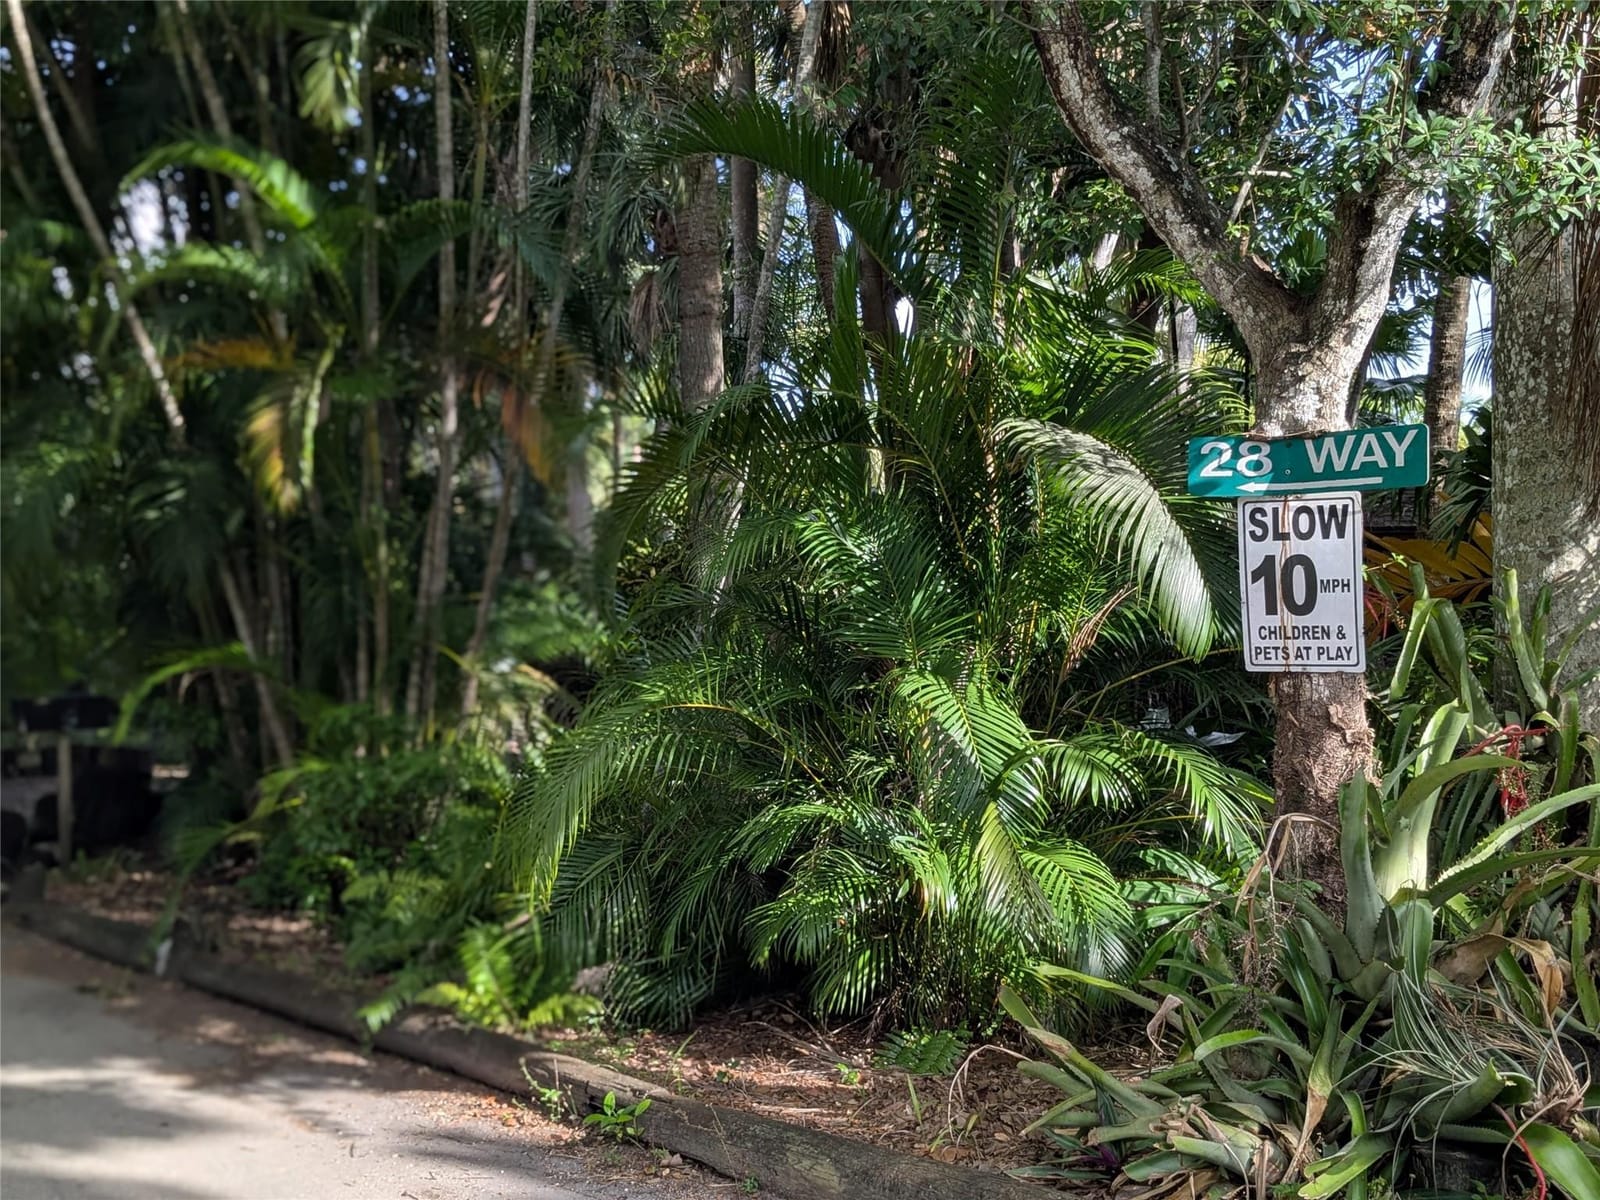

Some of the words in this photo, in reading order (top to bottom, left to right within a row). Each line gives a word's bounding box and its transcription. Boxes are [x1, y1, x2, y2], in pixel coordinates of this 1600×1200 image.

[1200, 441, 1273, 478] 28
[1304, 429, 1419, 474] WAY
[1248, 504, 1349, 542] SLOW
[1250, 554, 1318, 617] 10
[1320, 578, 1351, 593] MPH
[1258, 625, 1331, 641] CHILDREN
[1336, 625, 1347, 640] &
[1254, 646, 1290, 661] PETS
[1294, 646, 1313, 661] AT
[1317, 646, 1353, 661] PLAY
